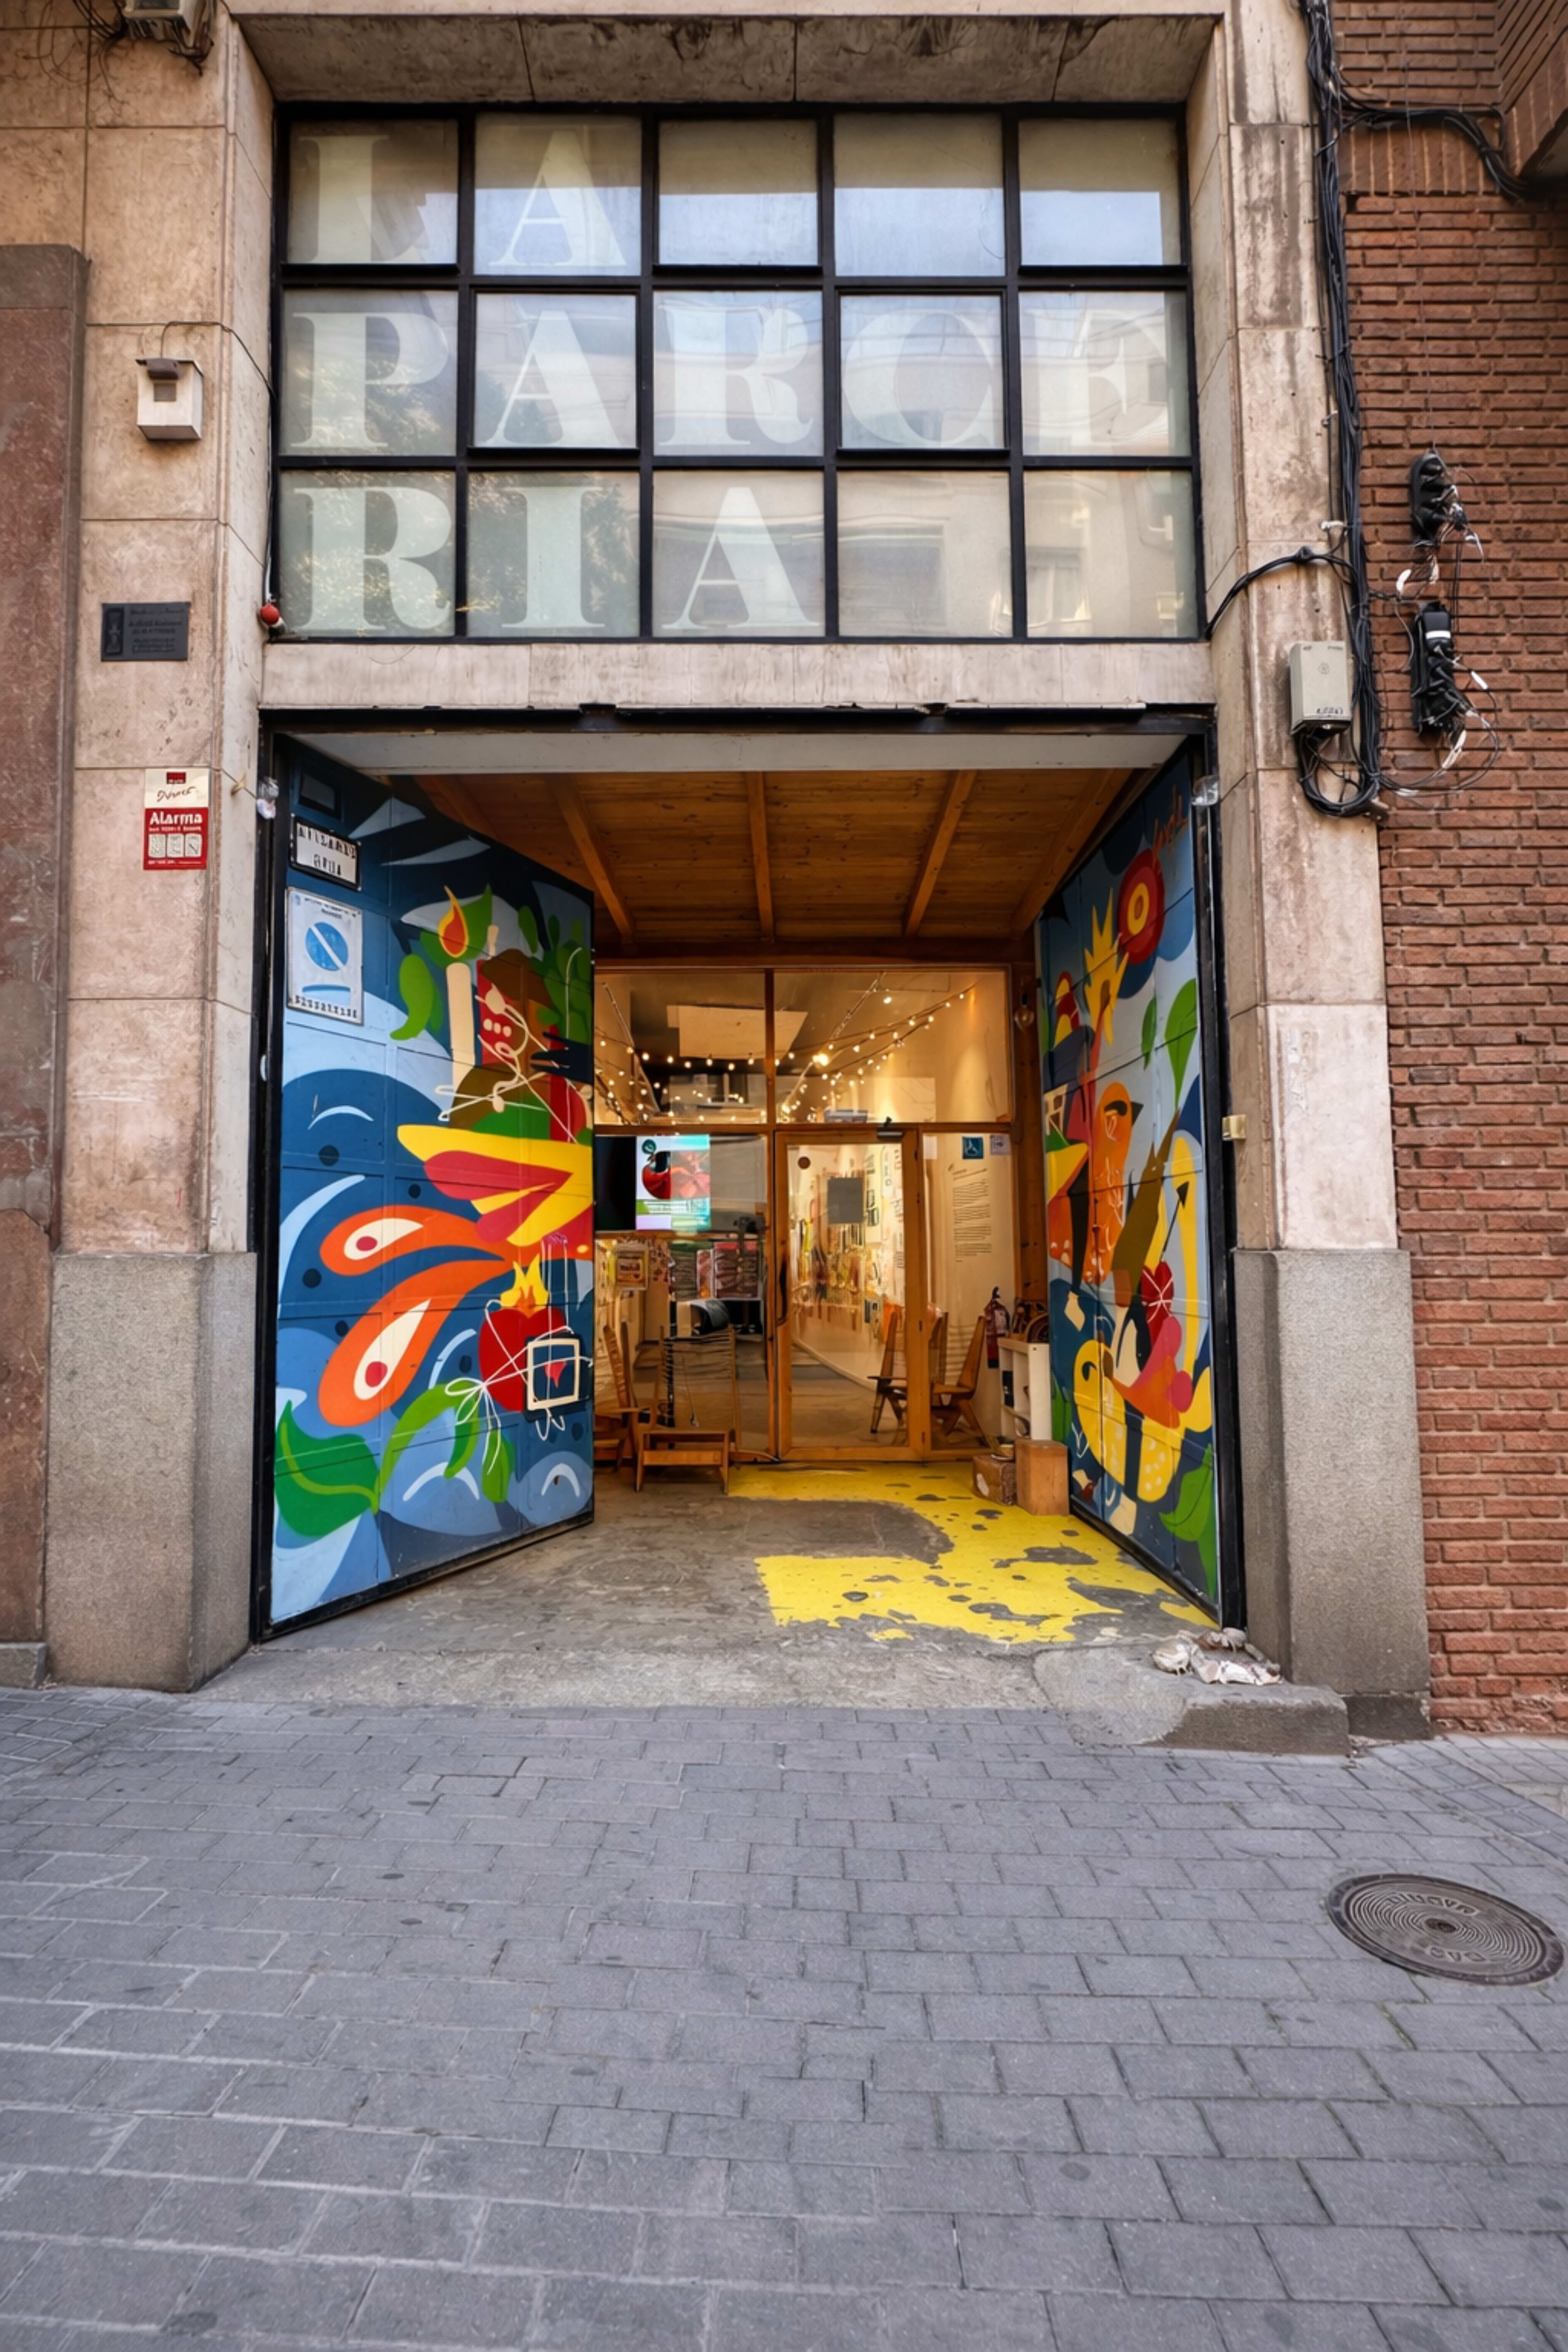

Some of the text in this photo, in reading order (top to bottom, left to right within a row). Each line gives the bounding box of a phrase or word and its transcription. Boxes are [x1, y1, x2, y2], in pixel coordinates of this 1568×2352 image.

[298, 130, 628, 265] LA
[290, 305, 1176, 448] PARCE
[292, 486, 821, 630] RIA
[149, 811, 203, 825] Alarma
